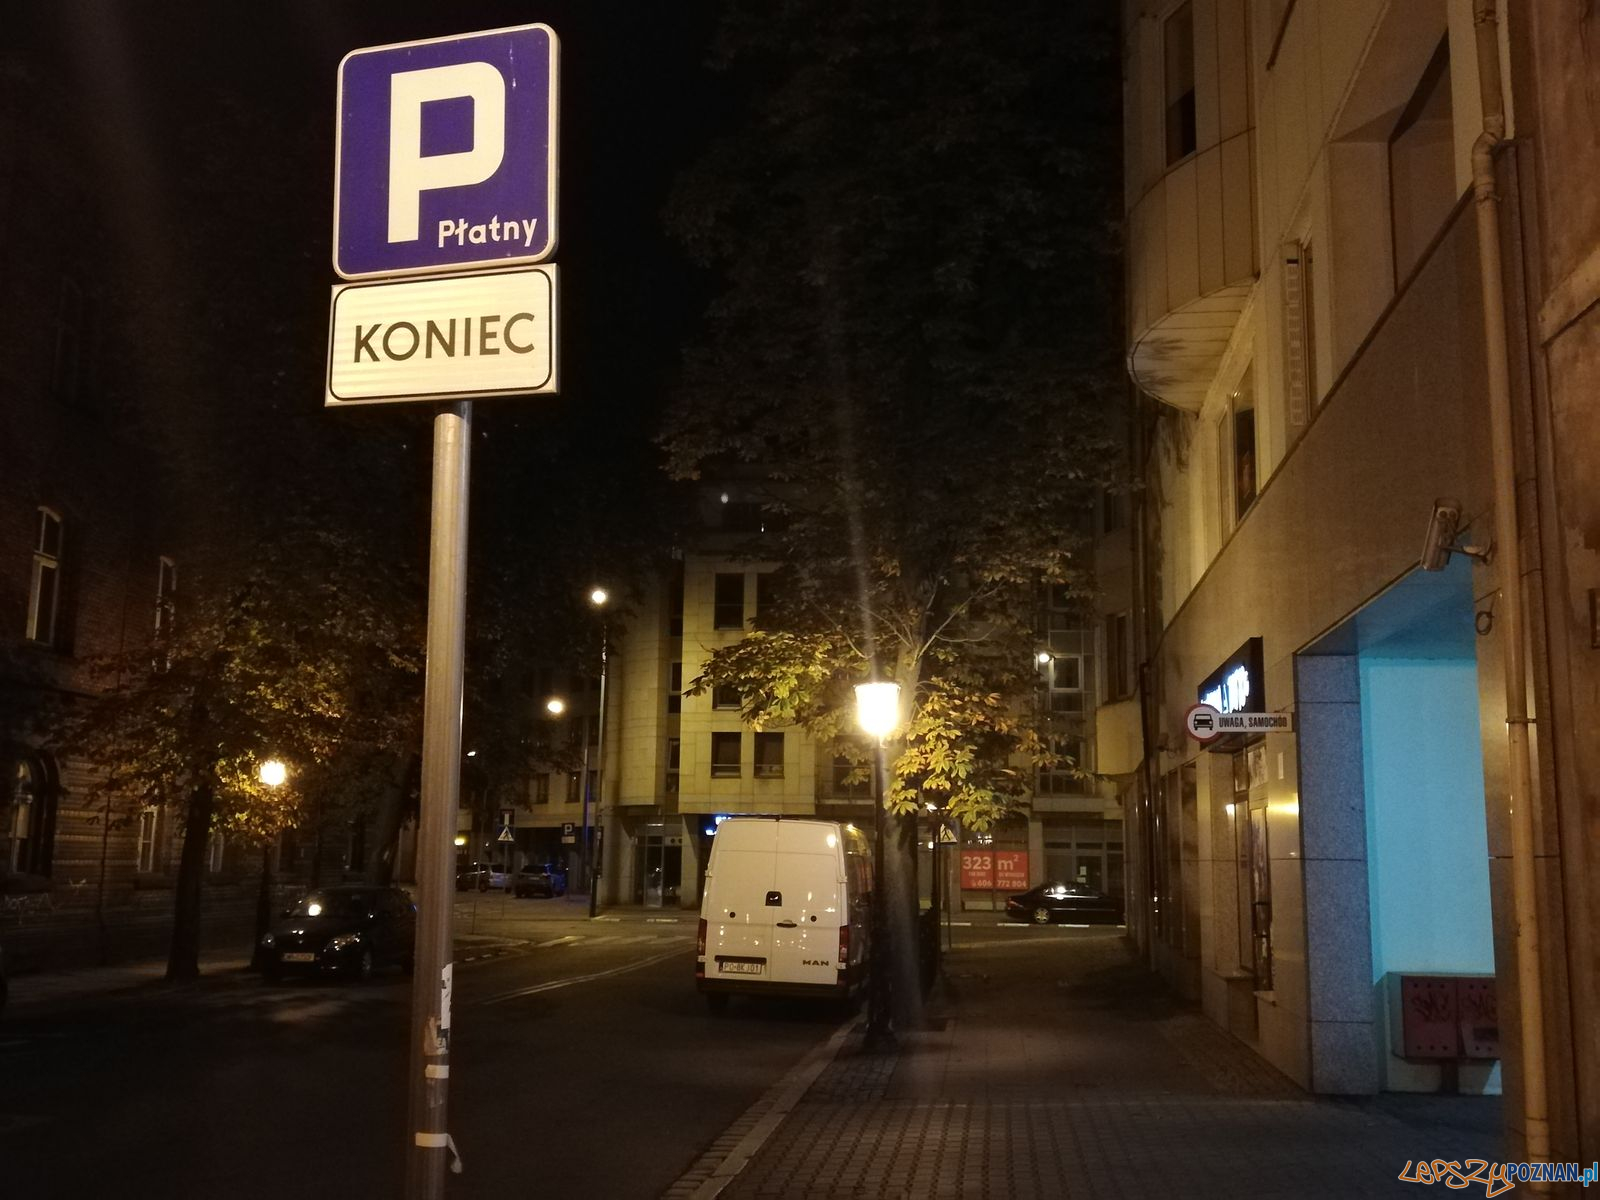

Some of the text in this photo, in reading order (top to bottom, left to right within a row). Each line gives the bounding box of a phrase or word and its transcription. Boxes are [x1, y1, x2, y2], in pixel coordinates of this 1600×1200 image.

[388, 61, 506, 243] P
[438, 214, 537, 248] Płatny
[353, 312, 535, 363] KONIEC
[1219, 716, 1288, 729] UWAGA, SAMOCHÓD
[564, 823, 574, 835] P
[962, 856, 992, 870] 323
